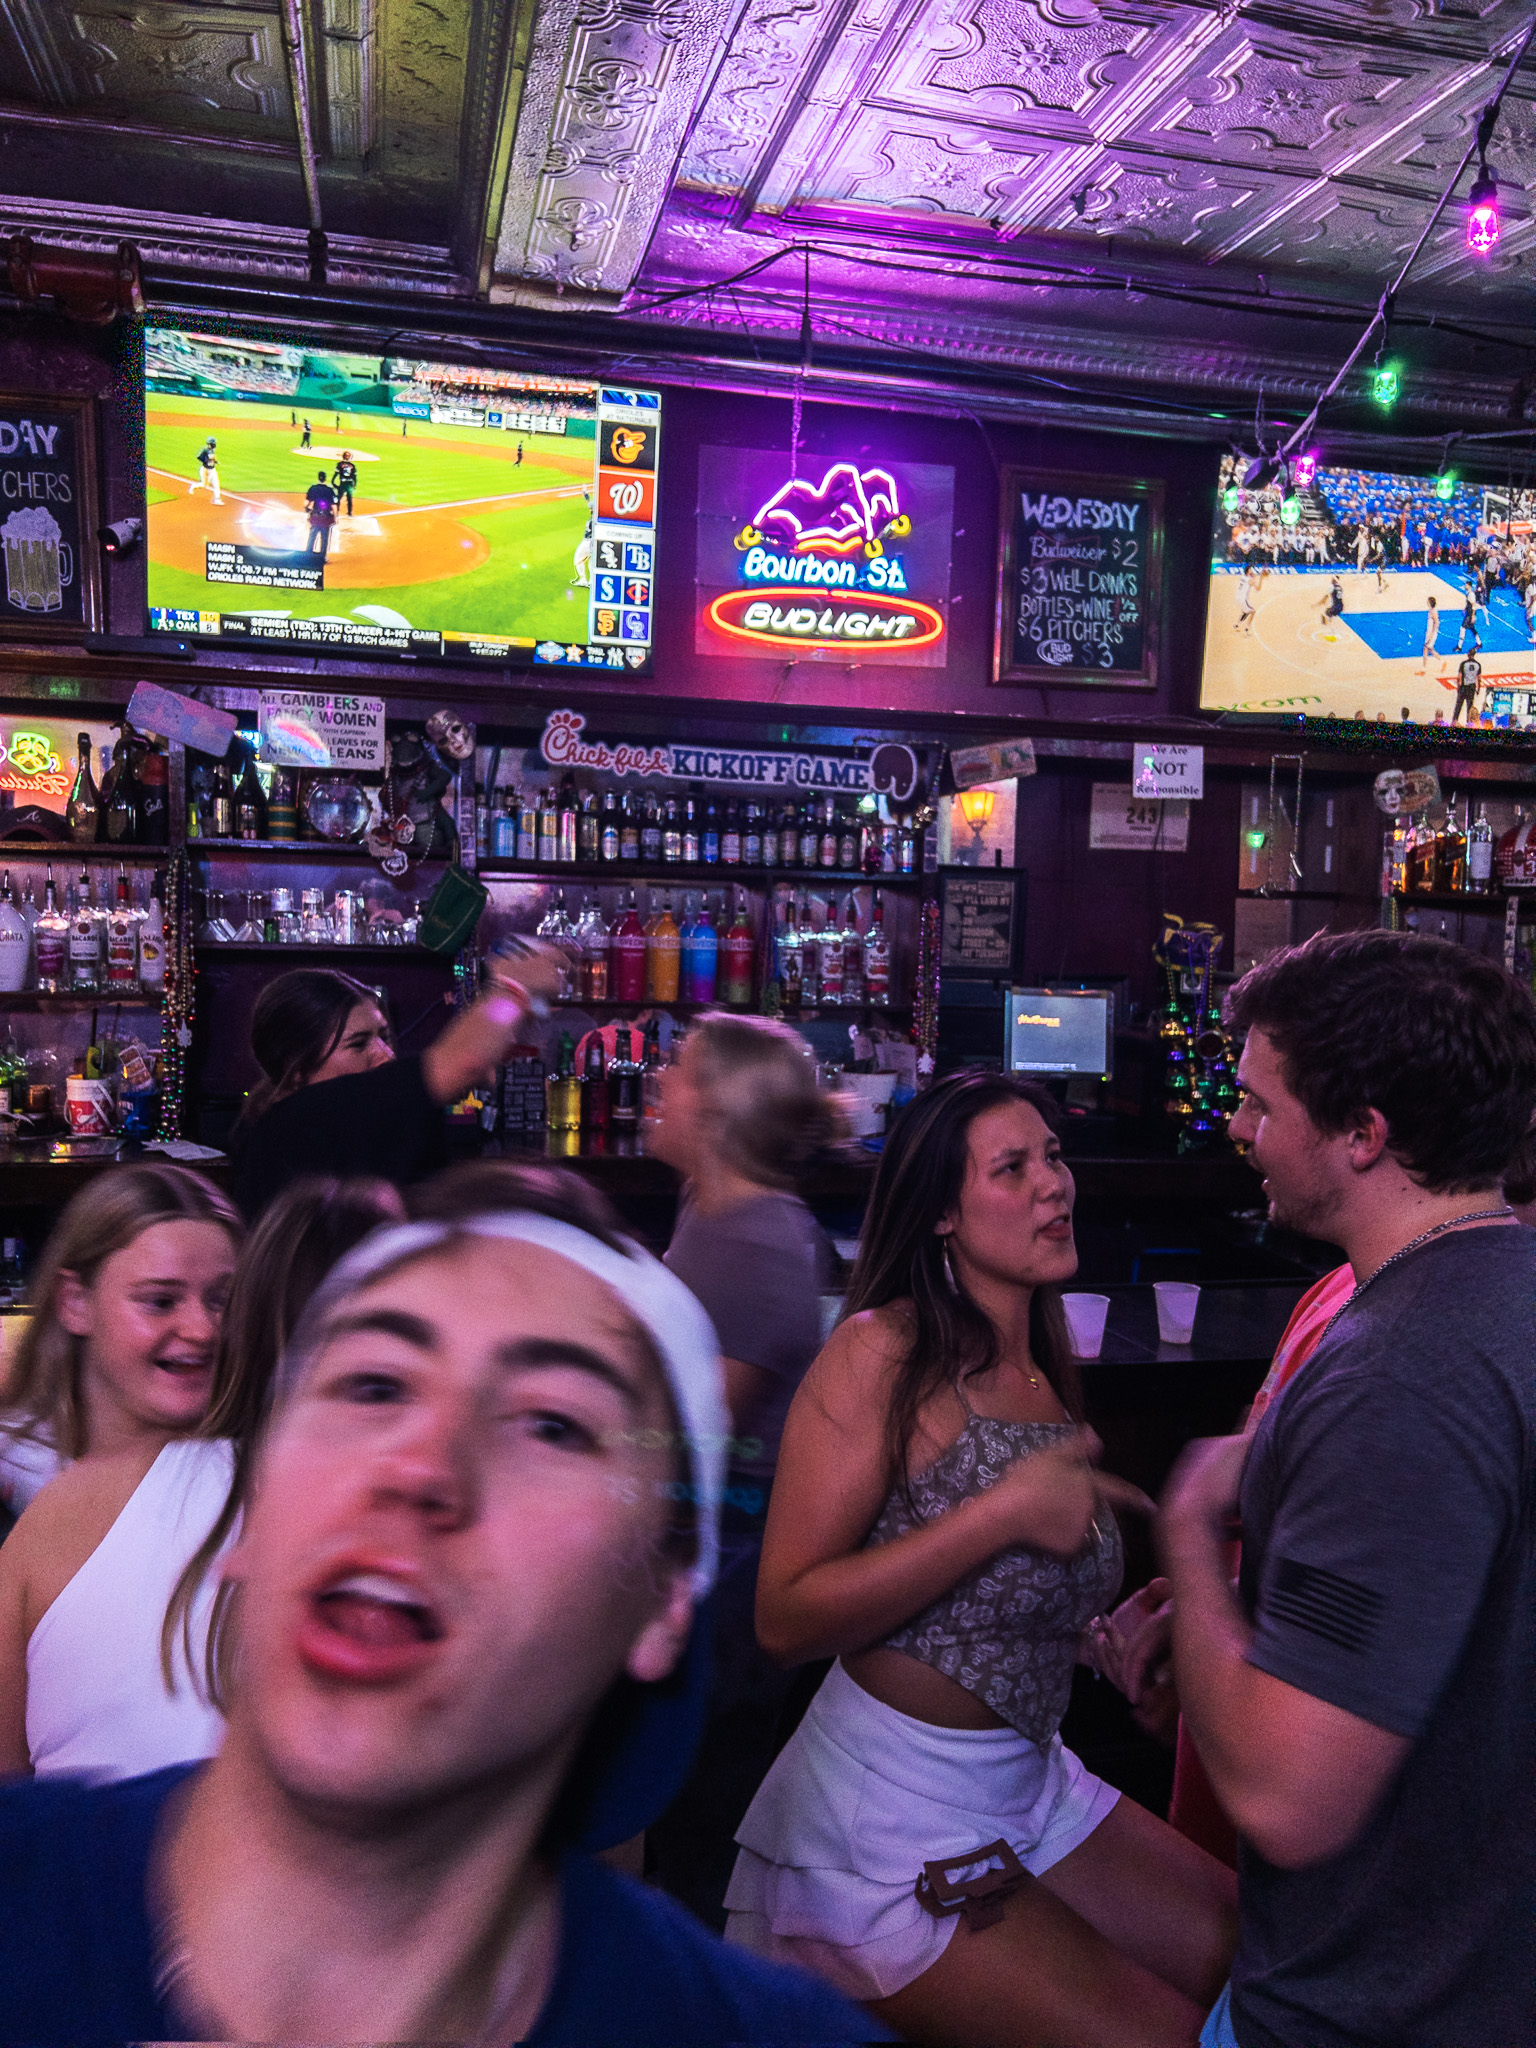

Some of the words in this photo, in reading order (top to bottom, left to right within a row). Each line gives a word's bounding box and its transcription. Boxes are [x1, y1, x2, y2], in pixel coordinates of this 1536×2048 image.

[0, 470, 72, 502] CHERS
[1021, 492, 1140, 532] WEDNESDAY
[207, 543, 236, 554] MASN
[1029, 536, 1107, 561] Budweiser
[1112, 538, 1139, 568] $2
[207, 553, 236, 563] MASN
[237, 555, 244, 565] 2
[743, 546, 856, 587] Bourbon
[262, 566, 278, 577] FM
[273, 577, 318, 590] NETWORK
[1020, 594, 1075, 619] BOTTLES
[1082, 597, 1115, 621] WINE
[175, 611, 195, 621] TEX
[744, 602, 817, 634] BUD
[817, 608, 917, 638] LIGHT
[1119, 612, 1139, 623] OFF
[175, 620, 198, 632] OAK
[223, 621, 246, 631] FINAL
[250, 617, 289, 629] SEMIEN
[344, 625, 384, 637] CAREER
[411, 630, 441, 642] GAME
[1047, 617, 1124, 645] PITCHERS
[250, 627, 262, 636] AT
[263, 628, 290, 638] LEAST
[328, 633, 342, 642] OF
[353, 635, 377, 645] SUCH
[378, 637, 409, 648] GAMES
[281, 693, 360, 711] GAMBLERS
[362, 702, 383, 713] AND
[319, 711, 377, 728] WOMEN
[327, 737, 359, 748] LEAVES
[360, 739, 379, 749] FOR
[318, 747, 376, 761] LEANS
[1169, 747, 1188, 756] Are
[671, 749, 790, 783] KICKOFF
[796, 757, 870, 790] GAME
[1150, 761, 1189, 777] NOT
[1136, 784, 1200, 796] Responsible
